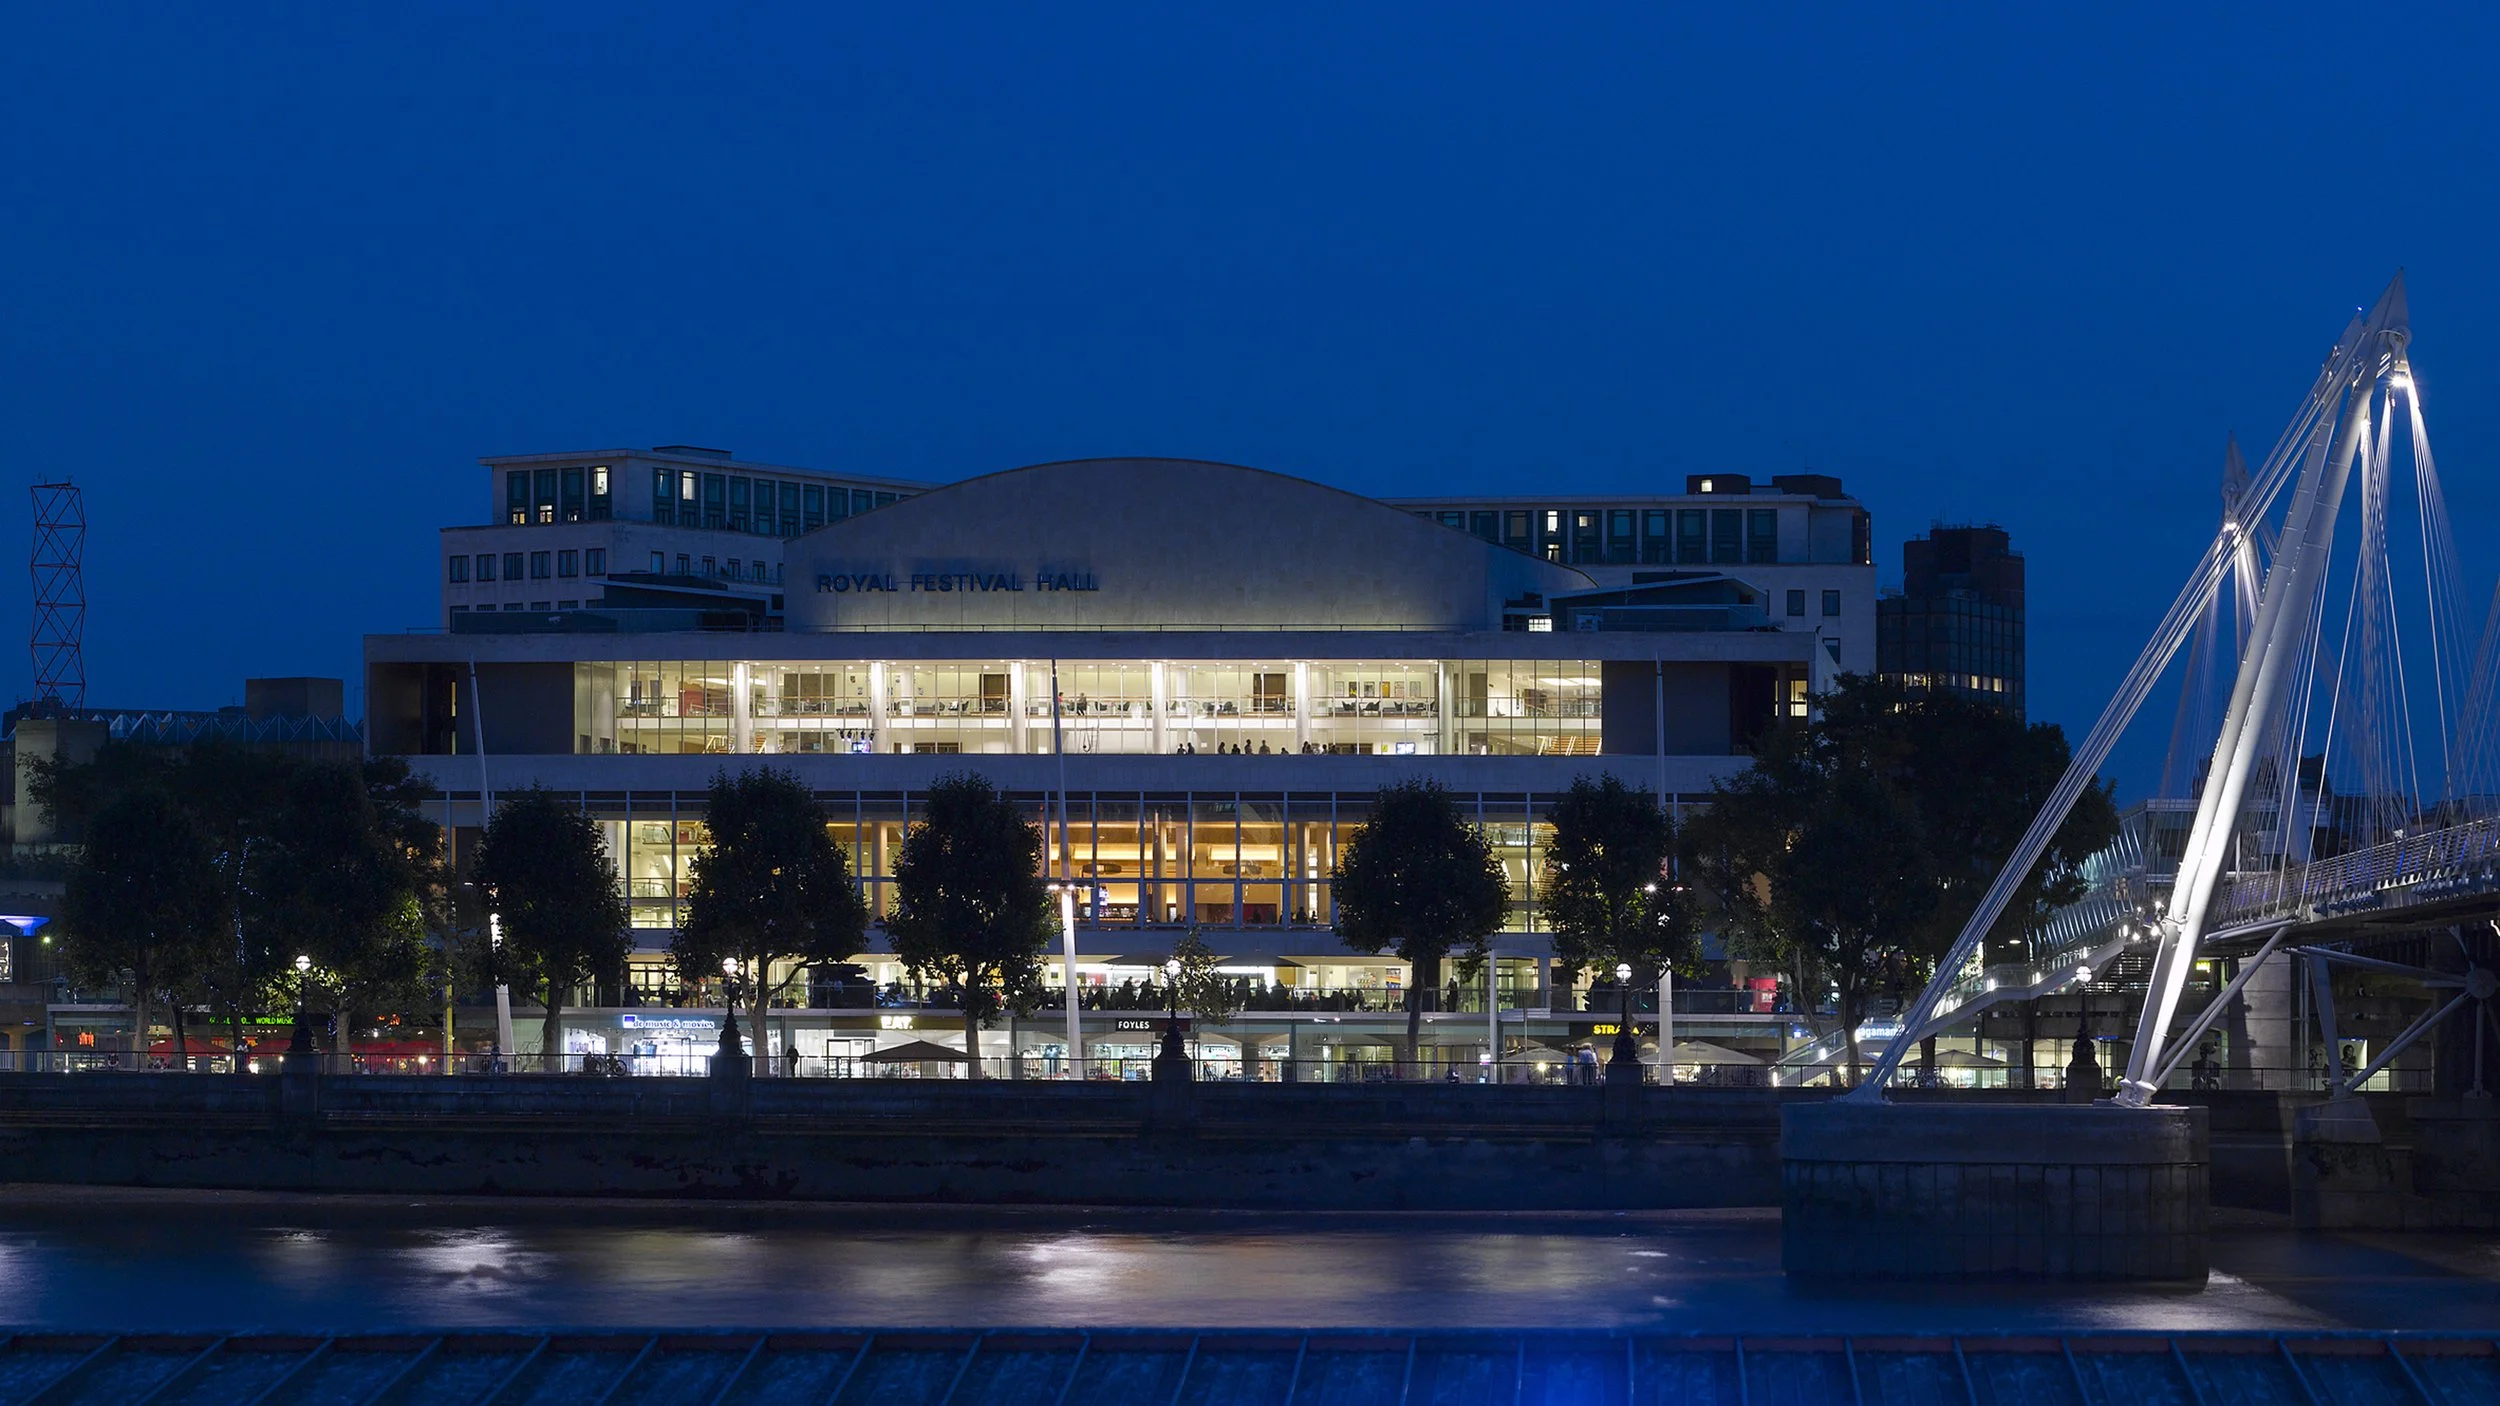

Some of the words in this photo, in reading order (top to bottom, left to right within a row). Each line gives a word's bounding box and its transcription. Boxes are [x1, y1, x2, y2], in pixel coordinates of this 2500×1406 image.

[817, 573, 899, 593] ROYAL
[910, 573, 1024, 592] FESTIVAL
[1037, 572, 1100, 592] HALL
[255, 1016, 276, 1025] WORLD
[682, 1019, 716, 1029] movies
[1117, 1020, 1150, 1029] FOYLES
[1593, 1024, 1640, 1035] STRAA
